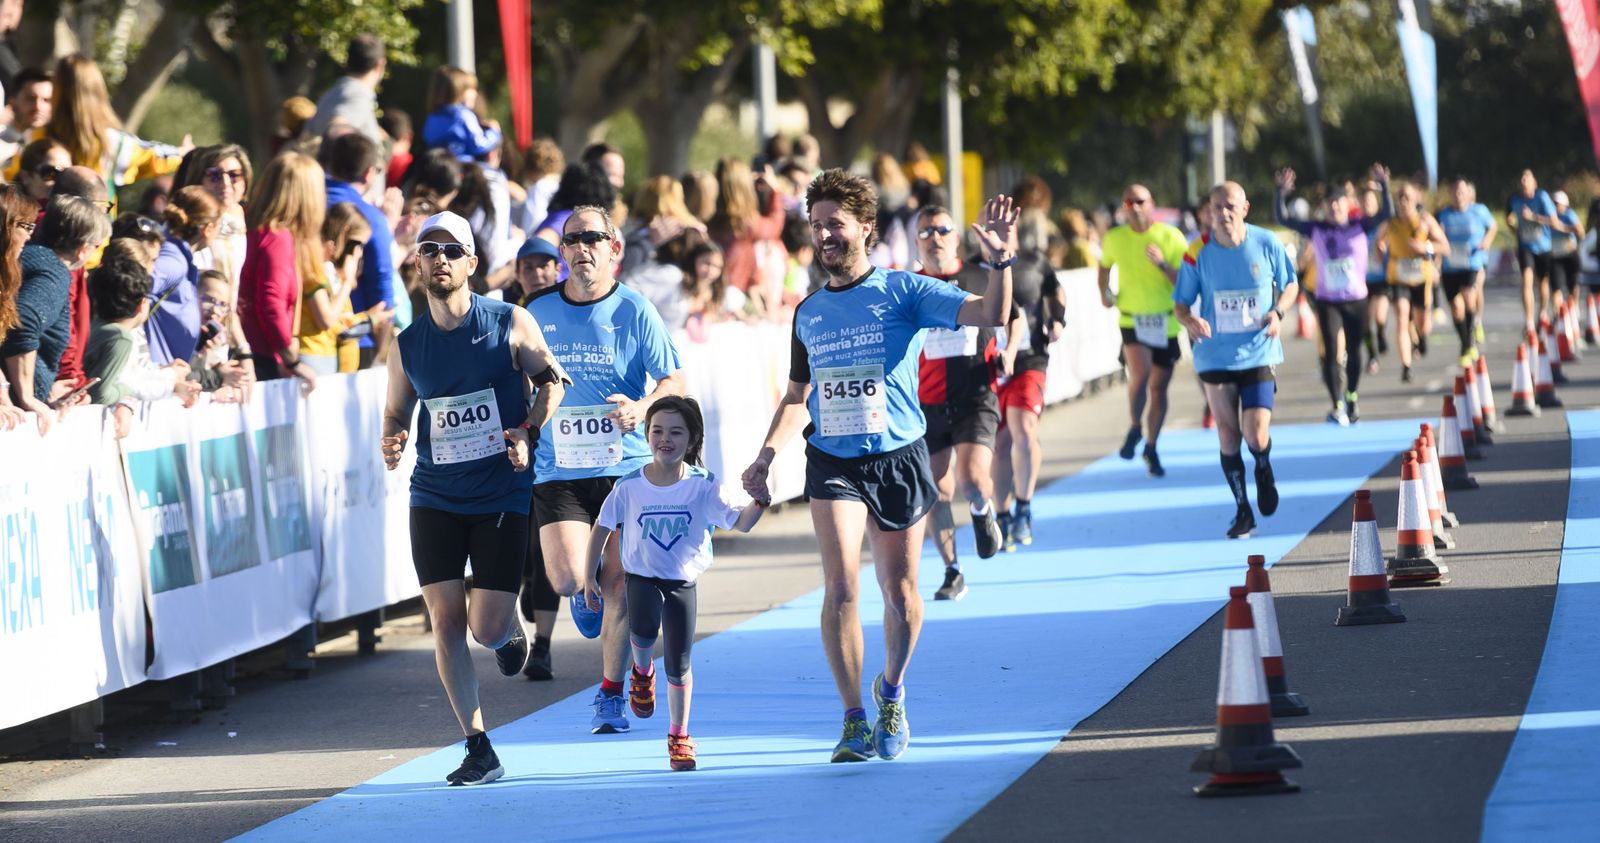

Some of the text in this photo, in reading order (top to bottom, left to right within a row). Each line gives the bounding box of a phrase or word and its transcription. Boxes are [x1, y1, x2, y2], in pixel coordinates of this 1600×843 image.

[809, 322, 884, 345] Medio Maratón
[549, 342, 614, 354] edio Maratón
[809, 332, 884, 358] Almería 2020
[583, 352, 614, 366] 2020
[835, 353, 852, 361] RUIZ
[824, 379, 876, 400] 5456
[437, 404, 491, 428] 5040
[463, 423, 483, 432] VALLE
[560, 418, 613, 435] 6108
